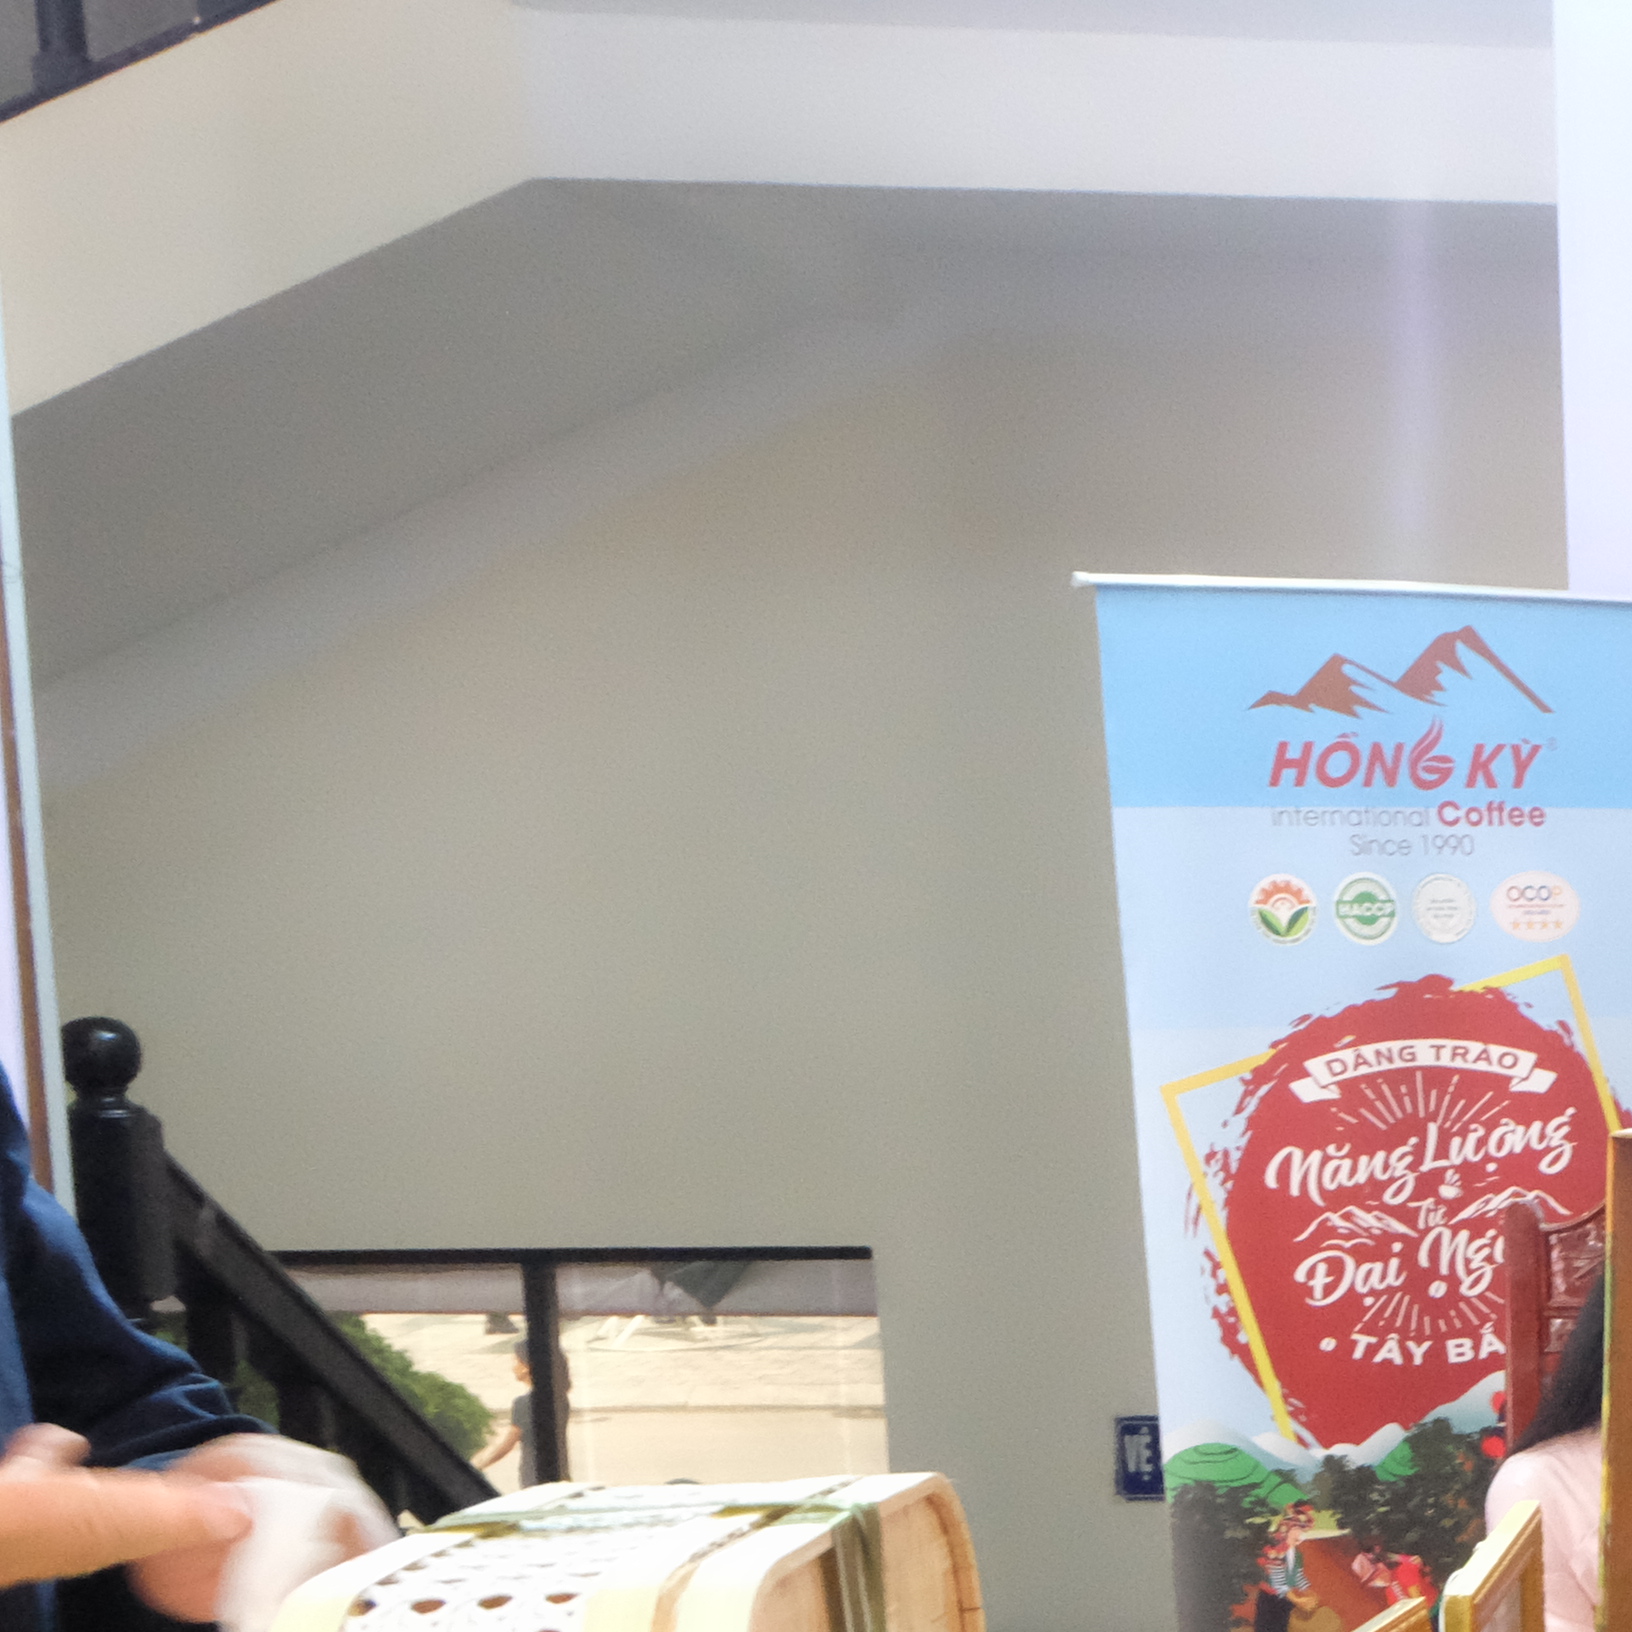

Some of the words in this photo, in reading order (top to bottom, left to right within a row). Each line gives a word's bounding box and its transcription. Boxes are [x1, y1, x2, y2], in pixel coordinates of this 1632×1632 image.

[1437, 800, 1547, 827] Coffee
[1349, 833, 1413, 857] Since
[1421, 833, 1475, 856] 1990
[1325, 1044, 1417, 1077] DÂNG
[1429, 1044, 1519, 1070] TRÀO
[1264, 1134, 1422, 1206] Năng
[1418, 1106, 1578, 1175] Lượng
[1353, 1335, 1432, 1367] TÂY
[1447, 1325, 1506, 1365] BẮ
